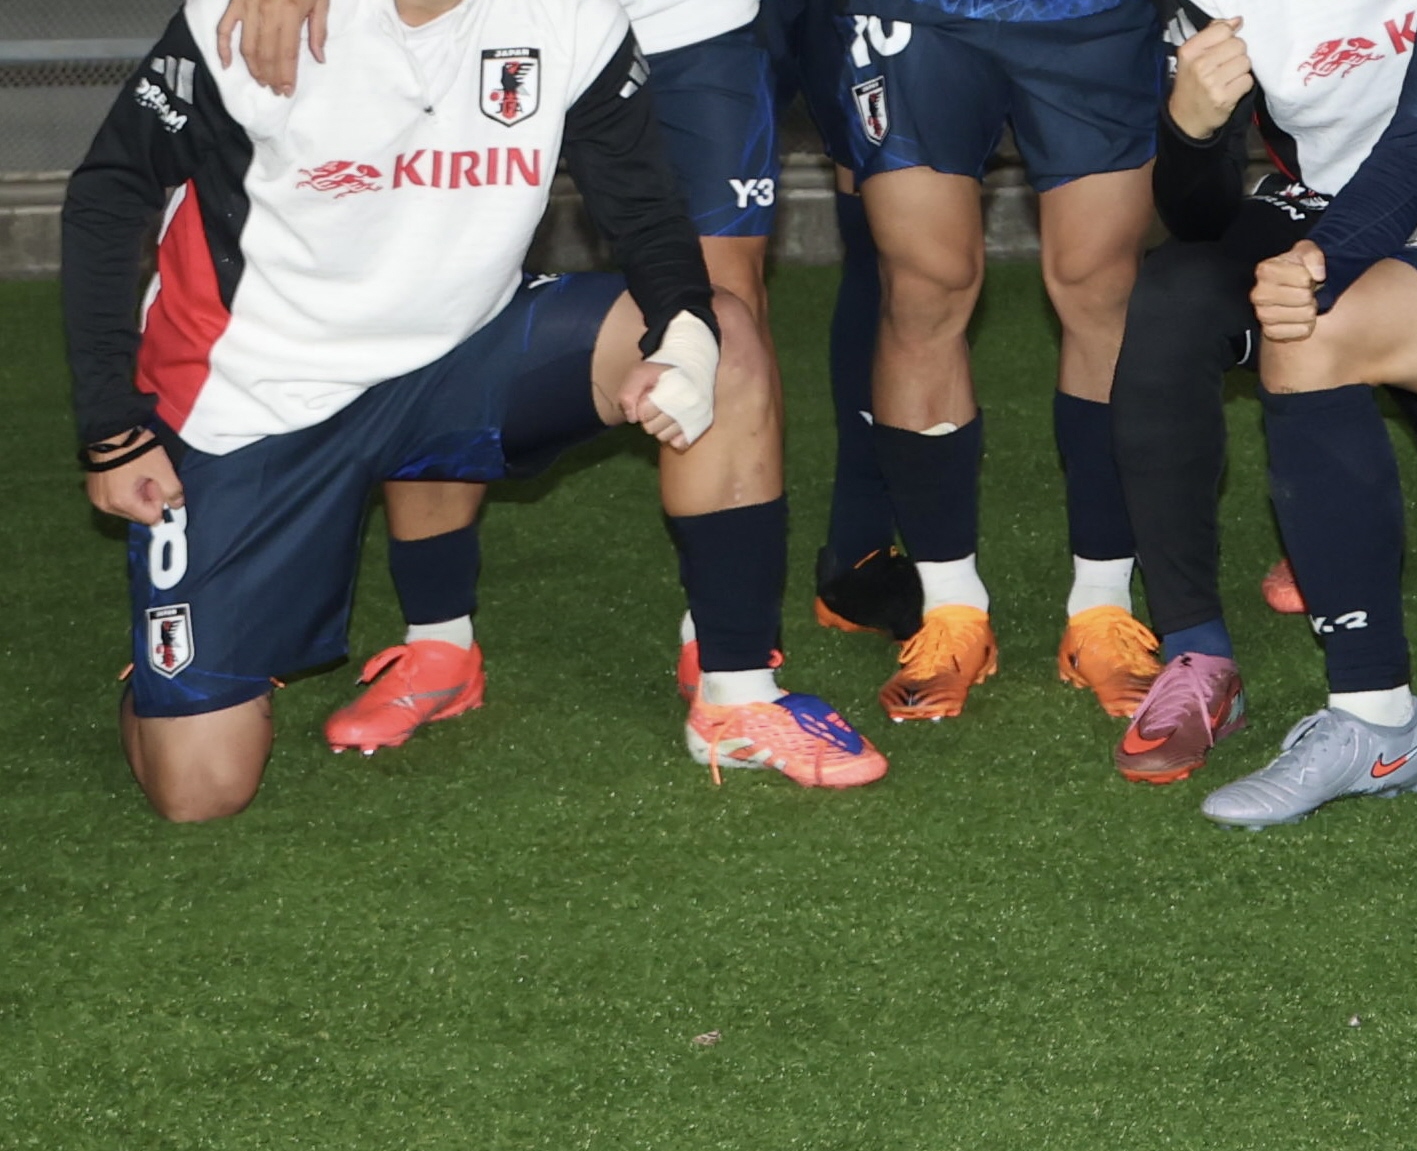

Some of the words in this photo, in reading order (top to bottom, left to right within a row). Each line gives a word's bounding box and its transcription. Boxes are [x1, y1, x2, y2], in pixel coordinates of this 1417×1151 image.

[493, 48, 530, 58] JAPAN
[392, 147, 541, 190] KIRIN
[729, 177, 775, 209] Y-3
